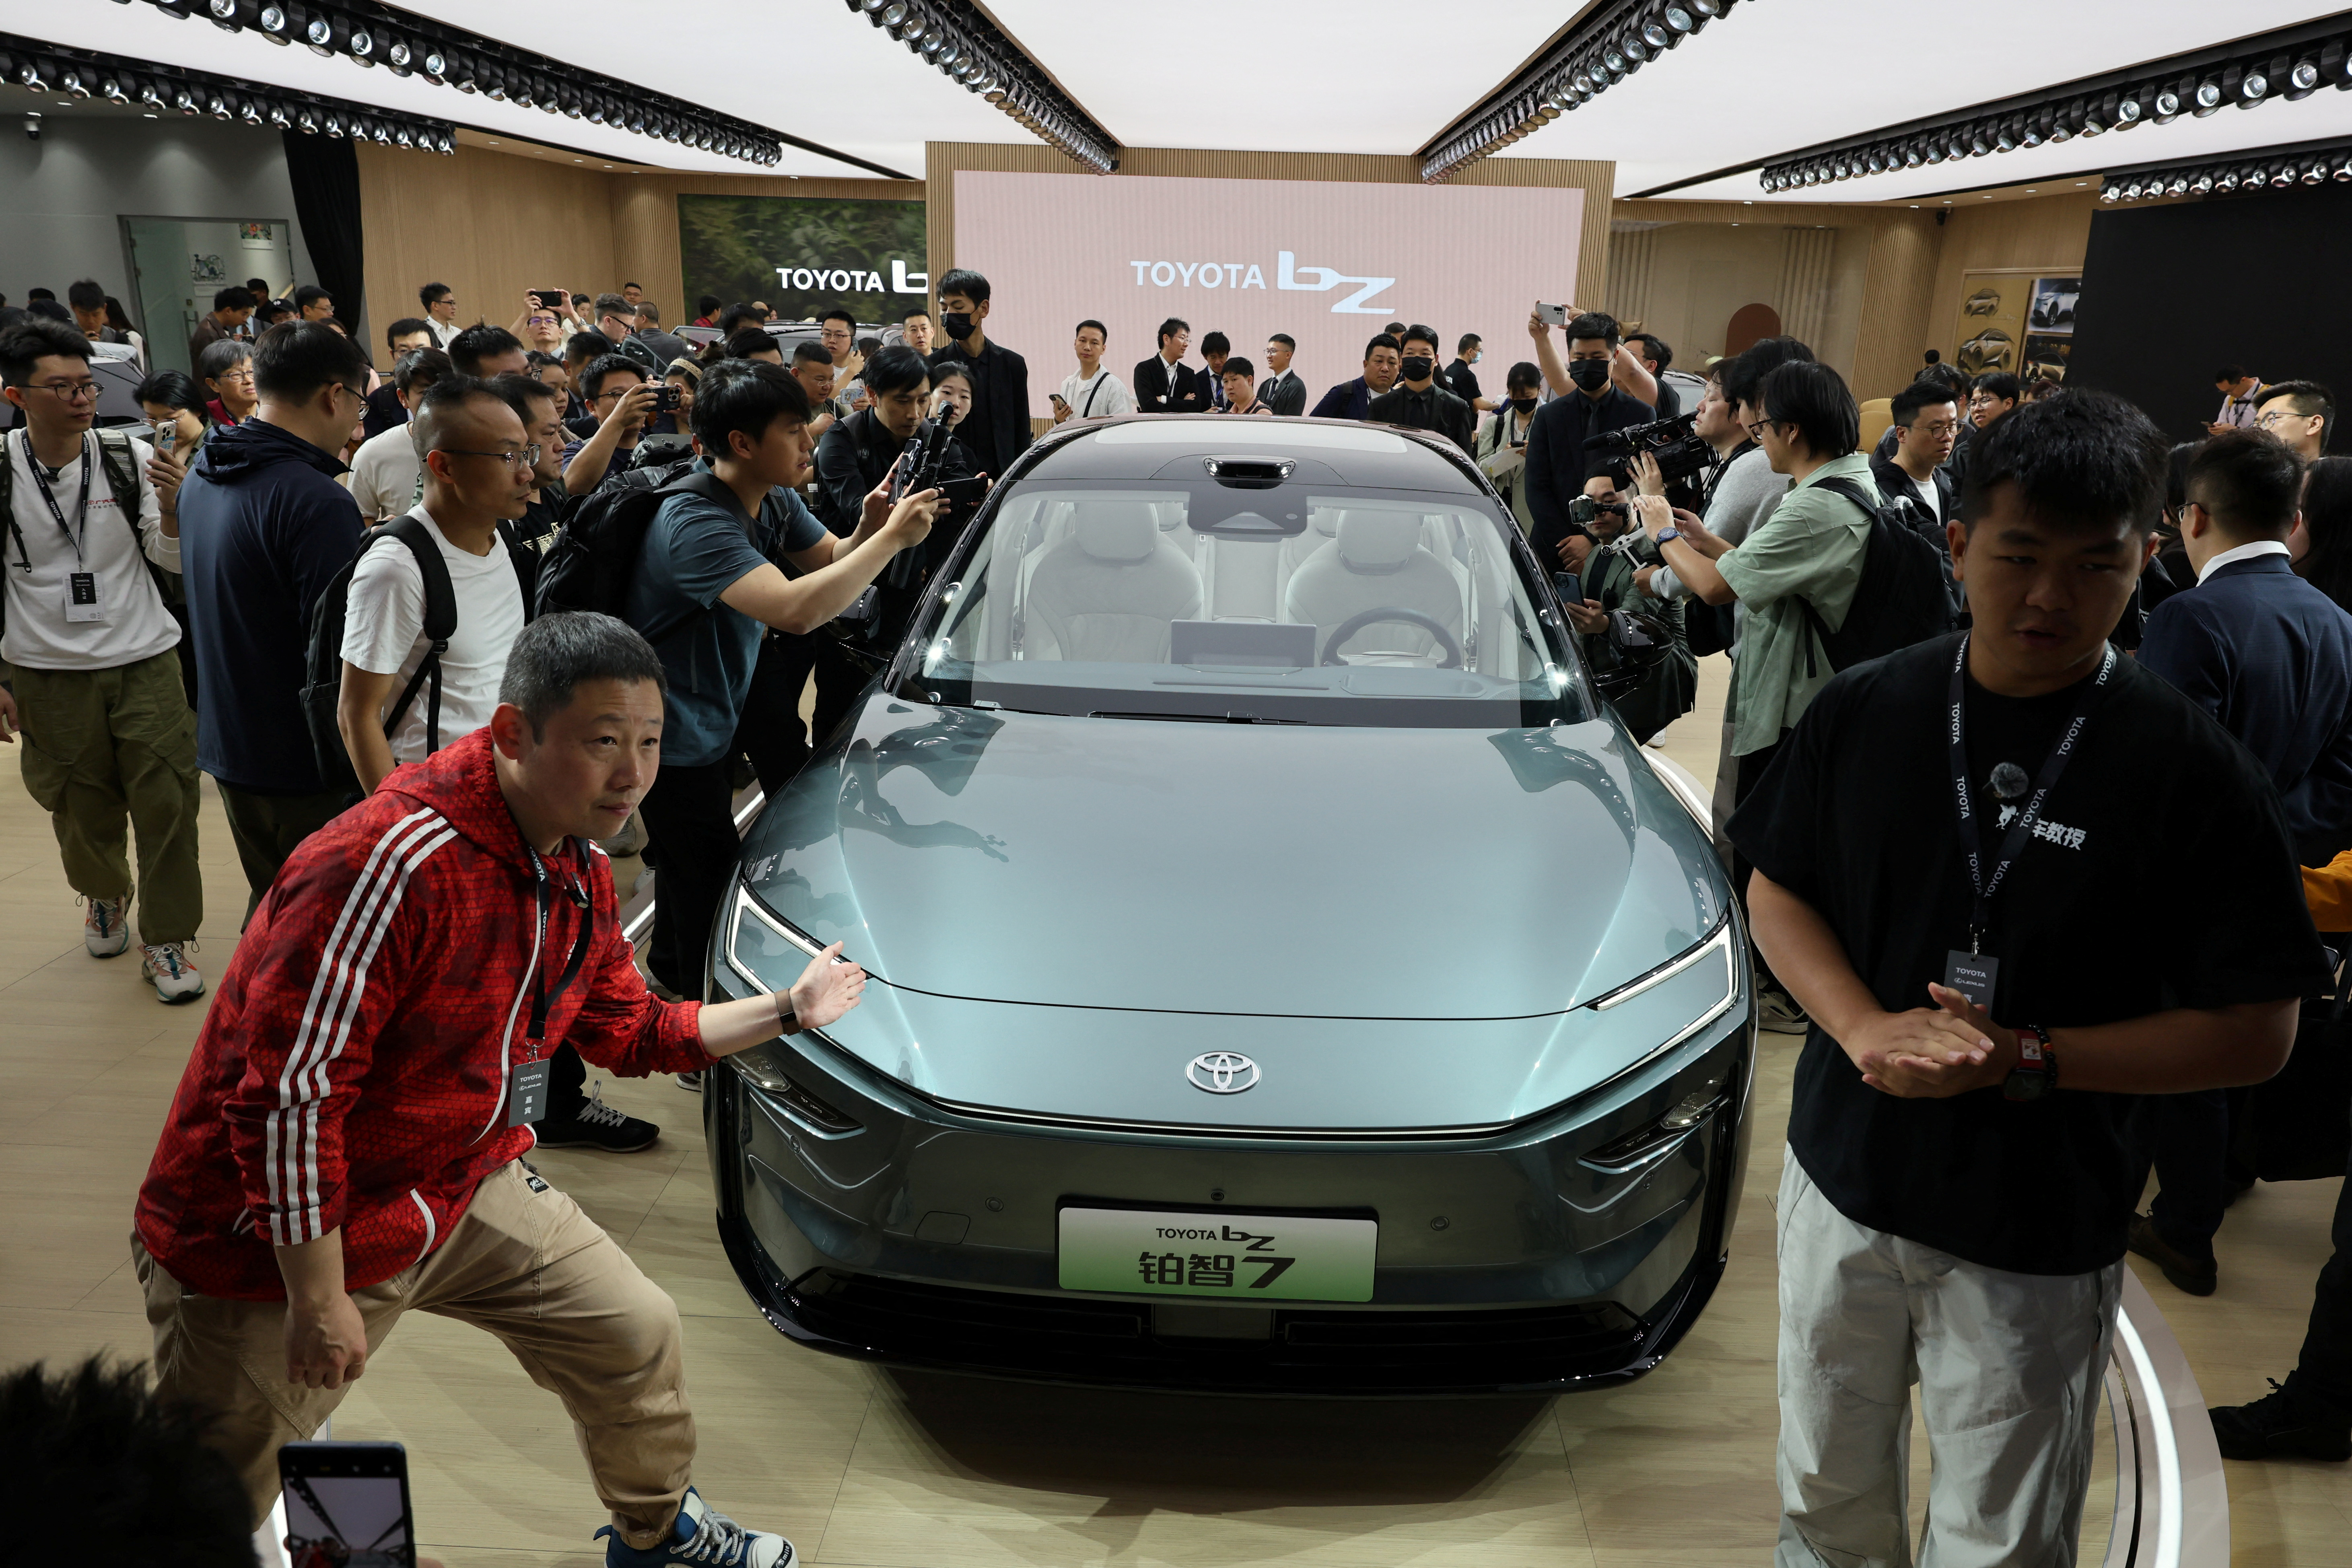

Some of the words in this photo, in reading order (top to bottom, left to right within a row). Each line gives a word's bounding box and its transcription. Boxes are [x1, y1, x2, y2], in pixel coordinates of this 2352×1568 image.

[776, 268, 885, 292] TOYOTA
[1130, 260, 1267, 290] TOYOTA
[23, 438, 31, 456] TOYOTA
[33, 469, 45, 488] TOYOTA
[49, 501, 62, 519] TOYOTA
[2095, 650, 2114, 686] TOYOTA
[1952, 702, 1960, 744] TOYOTA
[2057, 716, 2086, 755] TOYOTA
[1956, 776, 1970, 819] TOYOTA
[2019, 788, 2047, 828] TOYOTA
[529, 846, 546, 882] TOYOTA
[1968, 852, 1982, 894] TOYOTA
[1984, 860, 2011, 898] TOYOTA
[1956, 967, 1987, 978] TOYOTA
[520, 1074, 542, 1082] TOYOTA
[524, 1095, 533, 1115] 嘉宾
[1156, 1228, 1217, 1240] TOYOTA
[778, 1545, 790, 1565] Smile
